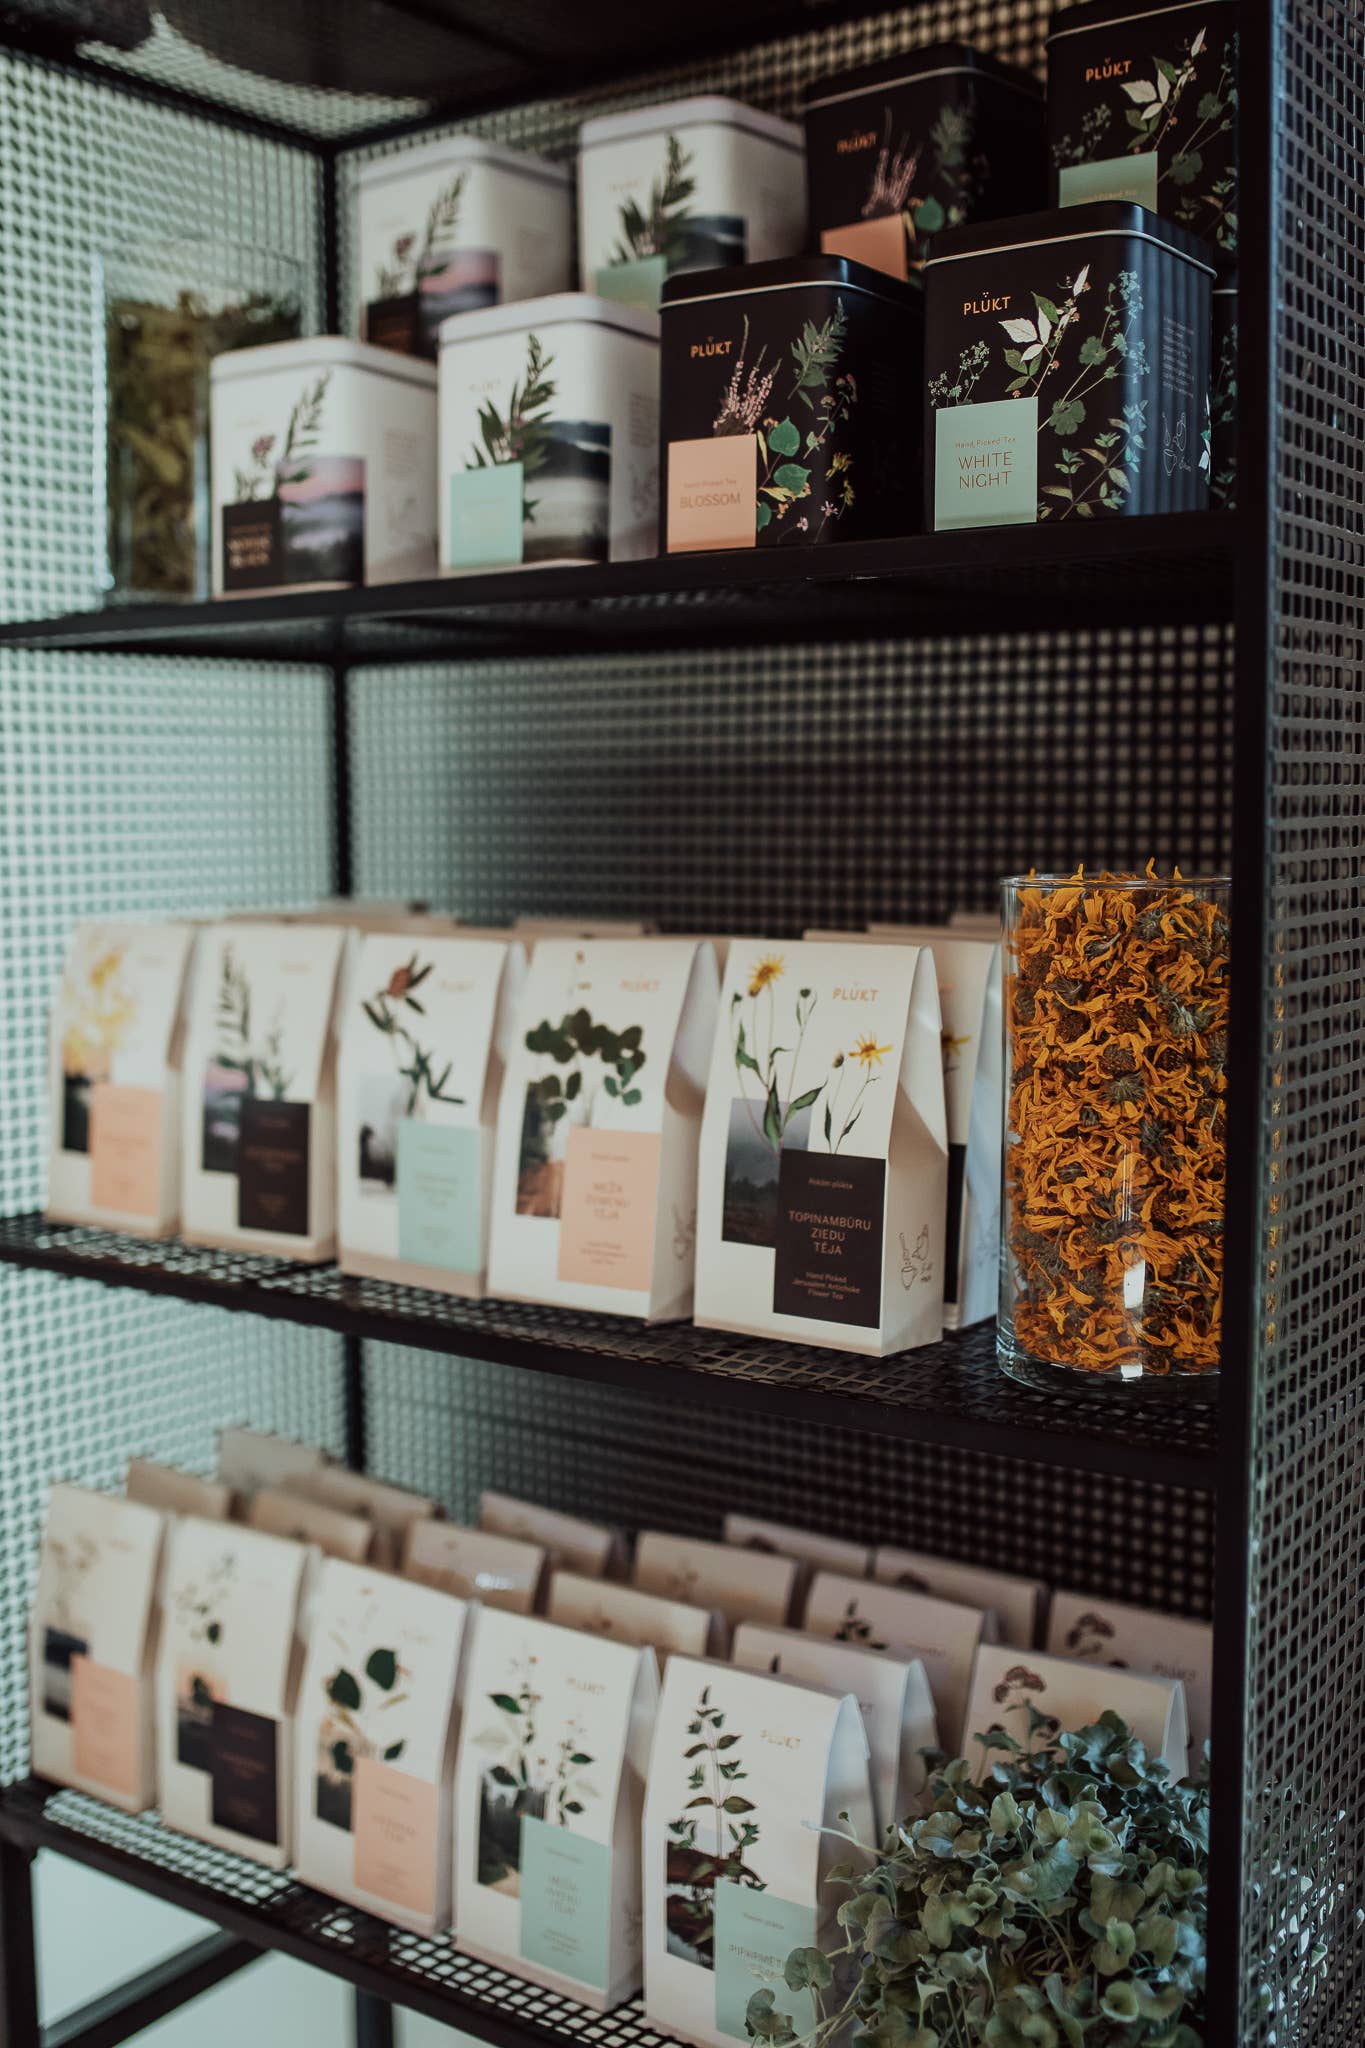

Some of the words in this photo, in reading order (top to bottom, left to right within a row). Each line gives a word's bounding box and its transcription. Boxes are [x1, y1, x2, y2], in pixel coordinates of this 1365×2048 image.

[976, 436, 1001, 447] Picked
[1003, 435, 1017, 444] Tea
[958, 451, 1014, 470] WHITE
[958, 470, 1013, 489] NIGHT
[679, 492, 742, 510] BLOSSOM
[810, 1227, 847, 1242] ZIEDU
